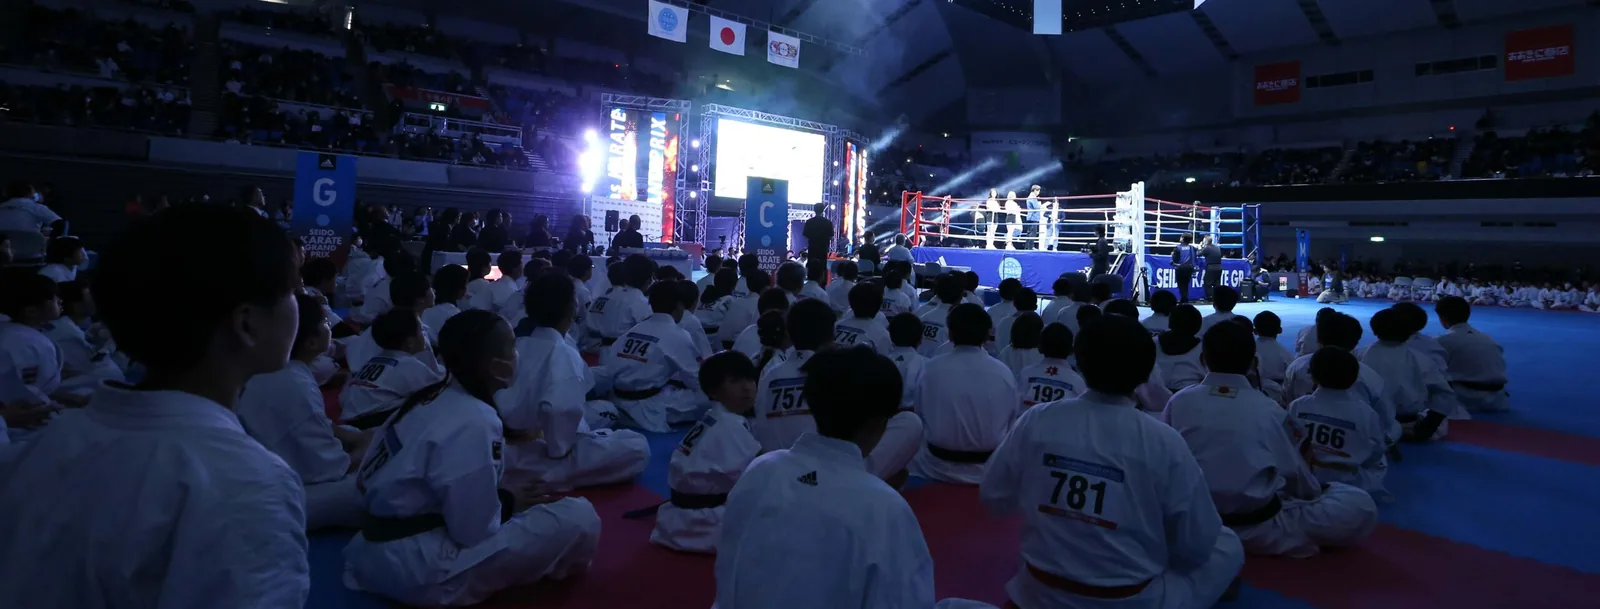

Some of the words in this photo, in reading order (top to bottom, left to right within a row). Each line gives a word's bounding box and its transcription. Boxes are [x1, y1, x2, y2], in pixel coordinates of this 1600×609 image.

[313, 178, 337, 207] G
[760, 201, 774, 228] C
[300, 236, 343, 245] KARATE
[304, 244, 336, 252] GRAND
[757, 248, 775, 256] SEIDO
[758, 256, 780, 264] ARATE
[623, 338, 651, 357] 974
[771, 386, 805, 410] 757
[1033, 384, 1065, 402] 192
[1304, 422, 1346, 449] 166
[1050, 471, 1107, 515] 781
